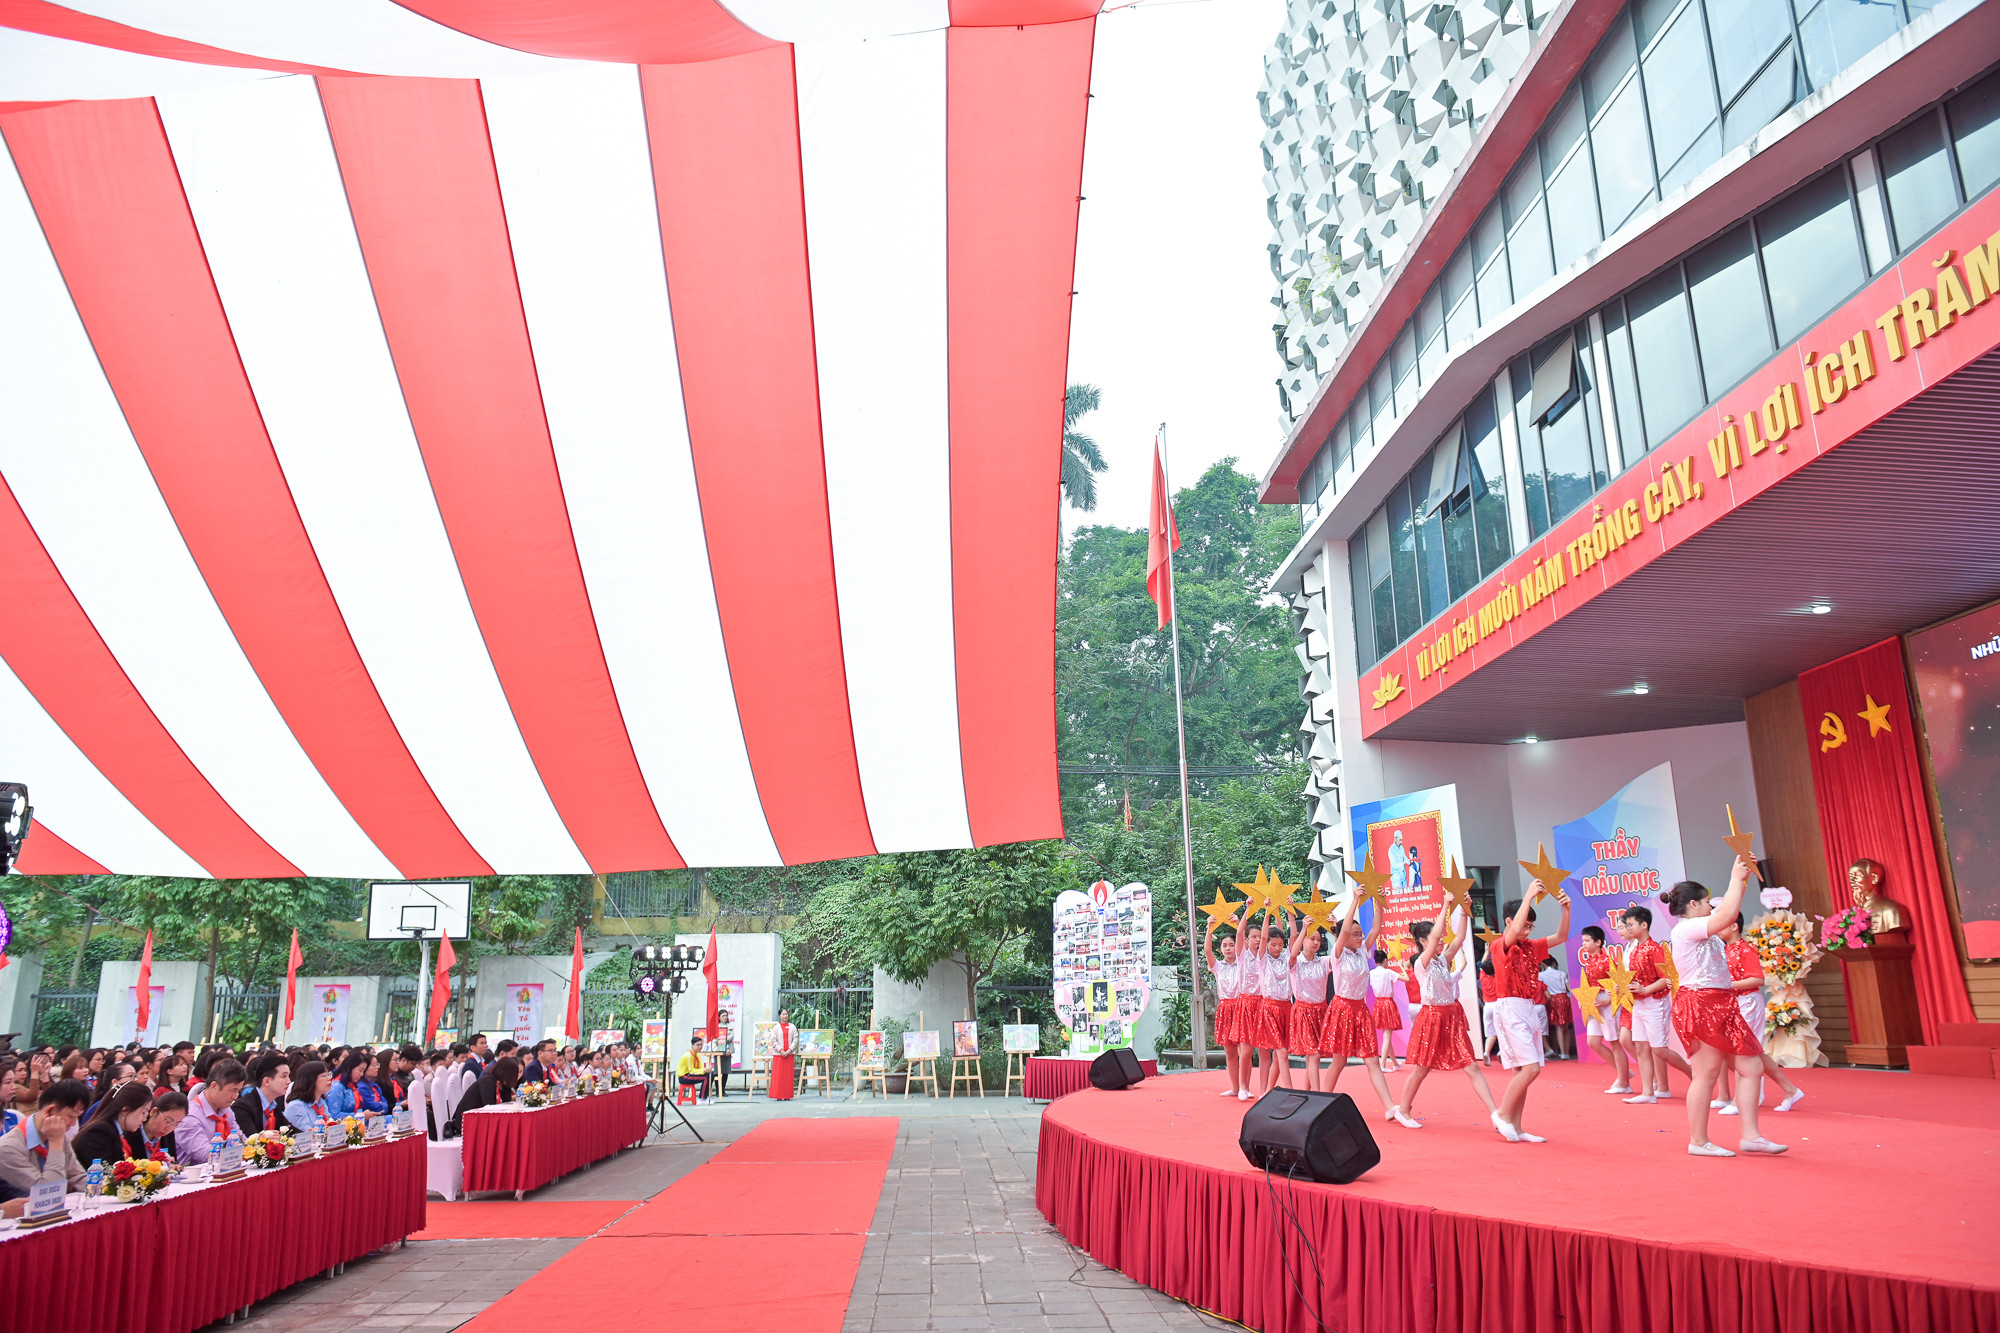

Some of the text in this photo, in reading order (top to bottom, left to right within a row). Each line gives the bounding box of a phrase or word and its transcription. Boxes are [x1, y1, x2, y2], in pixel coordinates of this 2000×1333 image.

[1416, 230, 2000, 680] VÌ LỢI ÍCH MƯỜI NĂM TRỒNG CÂY, VÌ LỢI ÍCH TRĂM
[1591, 827, 1641, 861] THẦY
[1582, 865, 1661, 897] MẪU MỰC
